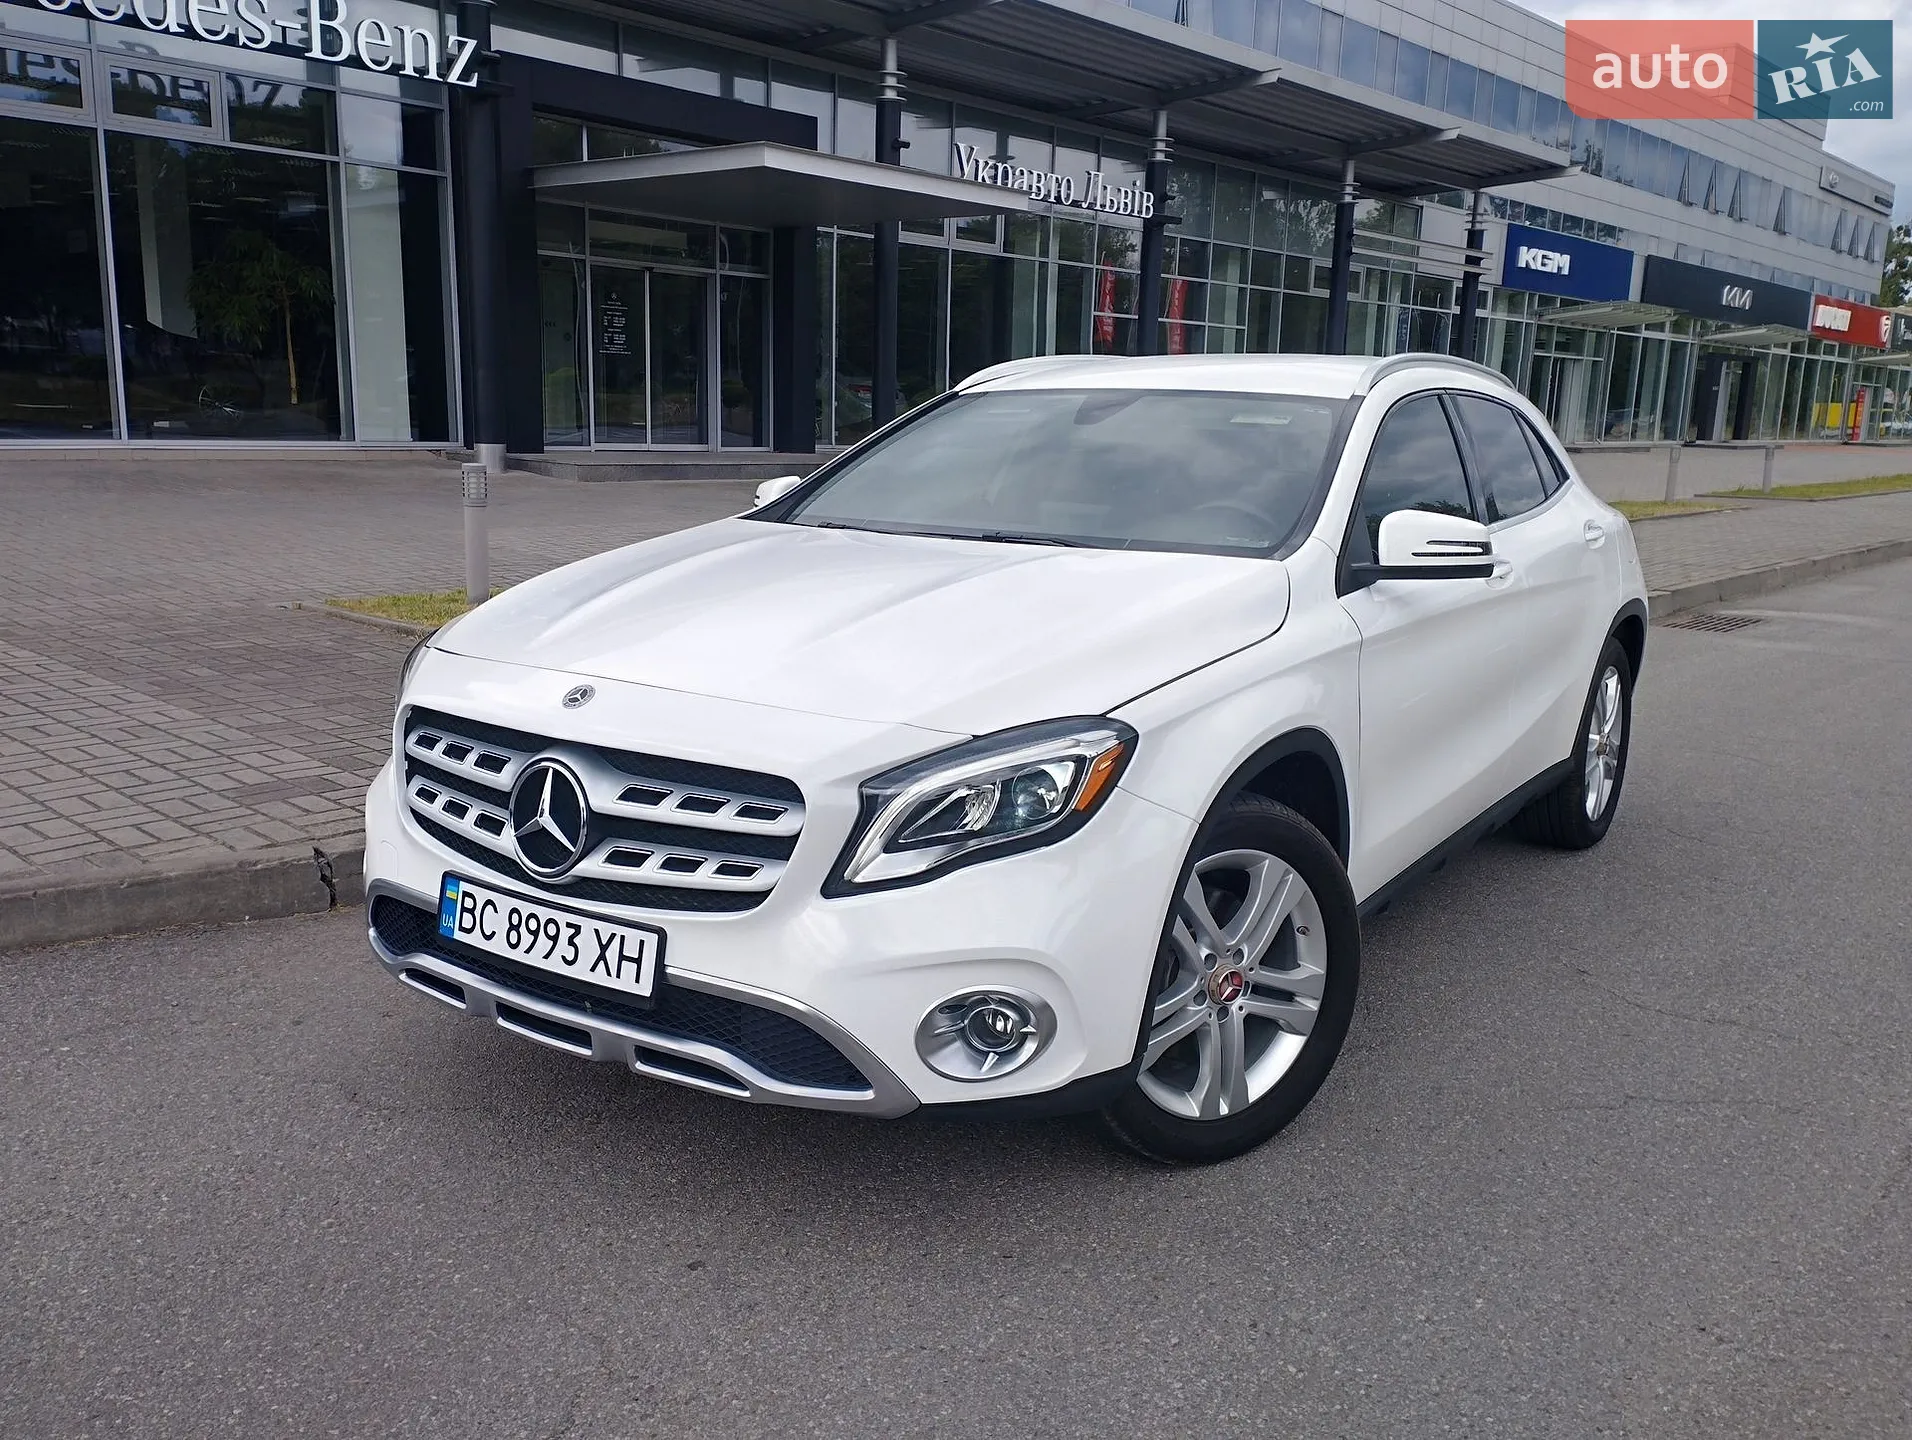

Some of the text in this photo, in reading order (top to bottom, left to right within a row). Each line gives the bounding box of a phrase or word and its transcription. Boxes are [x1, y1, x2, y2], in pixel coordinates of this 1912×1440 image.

[1081, 170, 1154, 219] Львів
[1517, 246, 1571, 275] KGM
[442, 915, 454, 930] UA
[458, 890, 645, 984] BC 8993 XH
